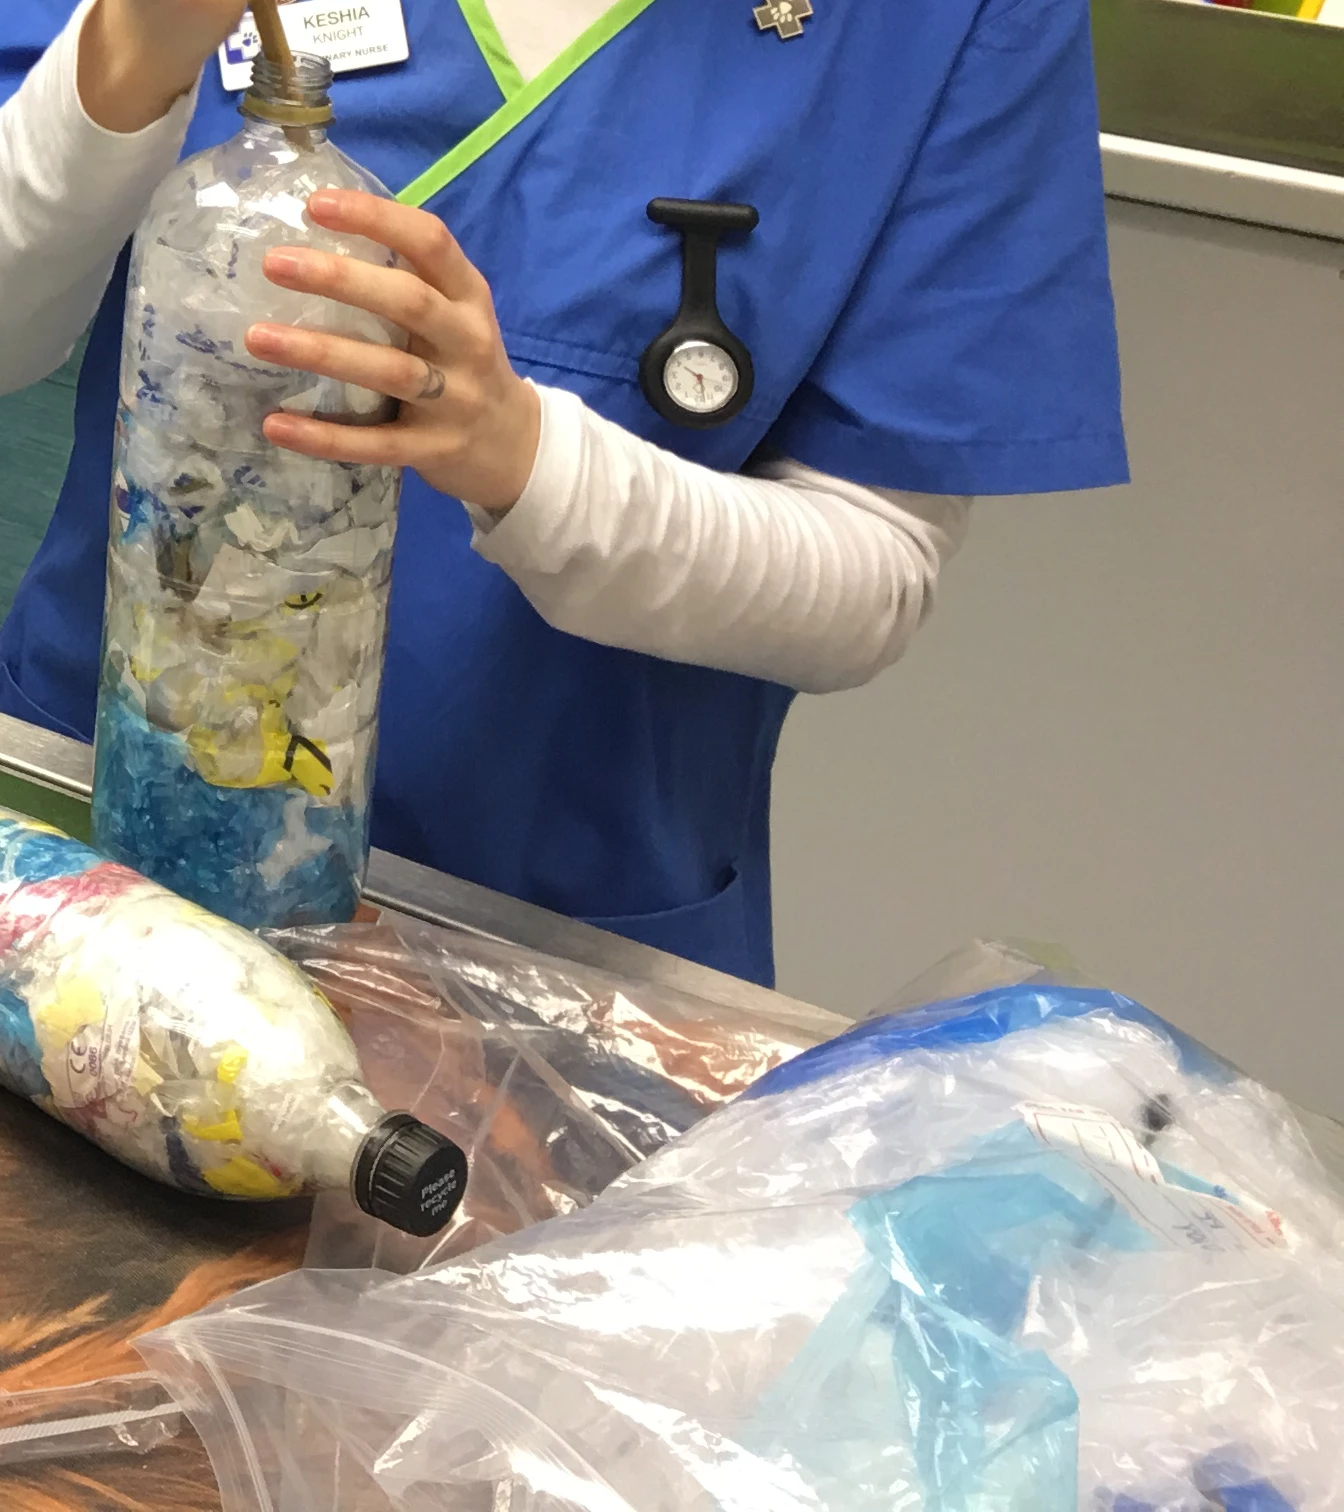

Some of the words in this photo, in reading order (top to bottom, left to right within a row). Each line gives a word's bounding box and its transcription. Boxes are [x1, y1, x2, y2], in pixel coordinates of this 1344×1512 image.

[303, 6, 370, 29] KESHIA
[313, 26, 364, 44] KNIGHT
[322, 51, 352, 61] NARY
[355, 44, 389, 56] NURSE
[421, 1169, 456, 1199] Please
[420, 1179, 457, 1212] recycle
[431, 1199, 448, 1216] me
